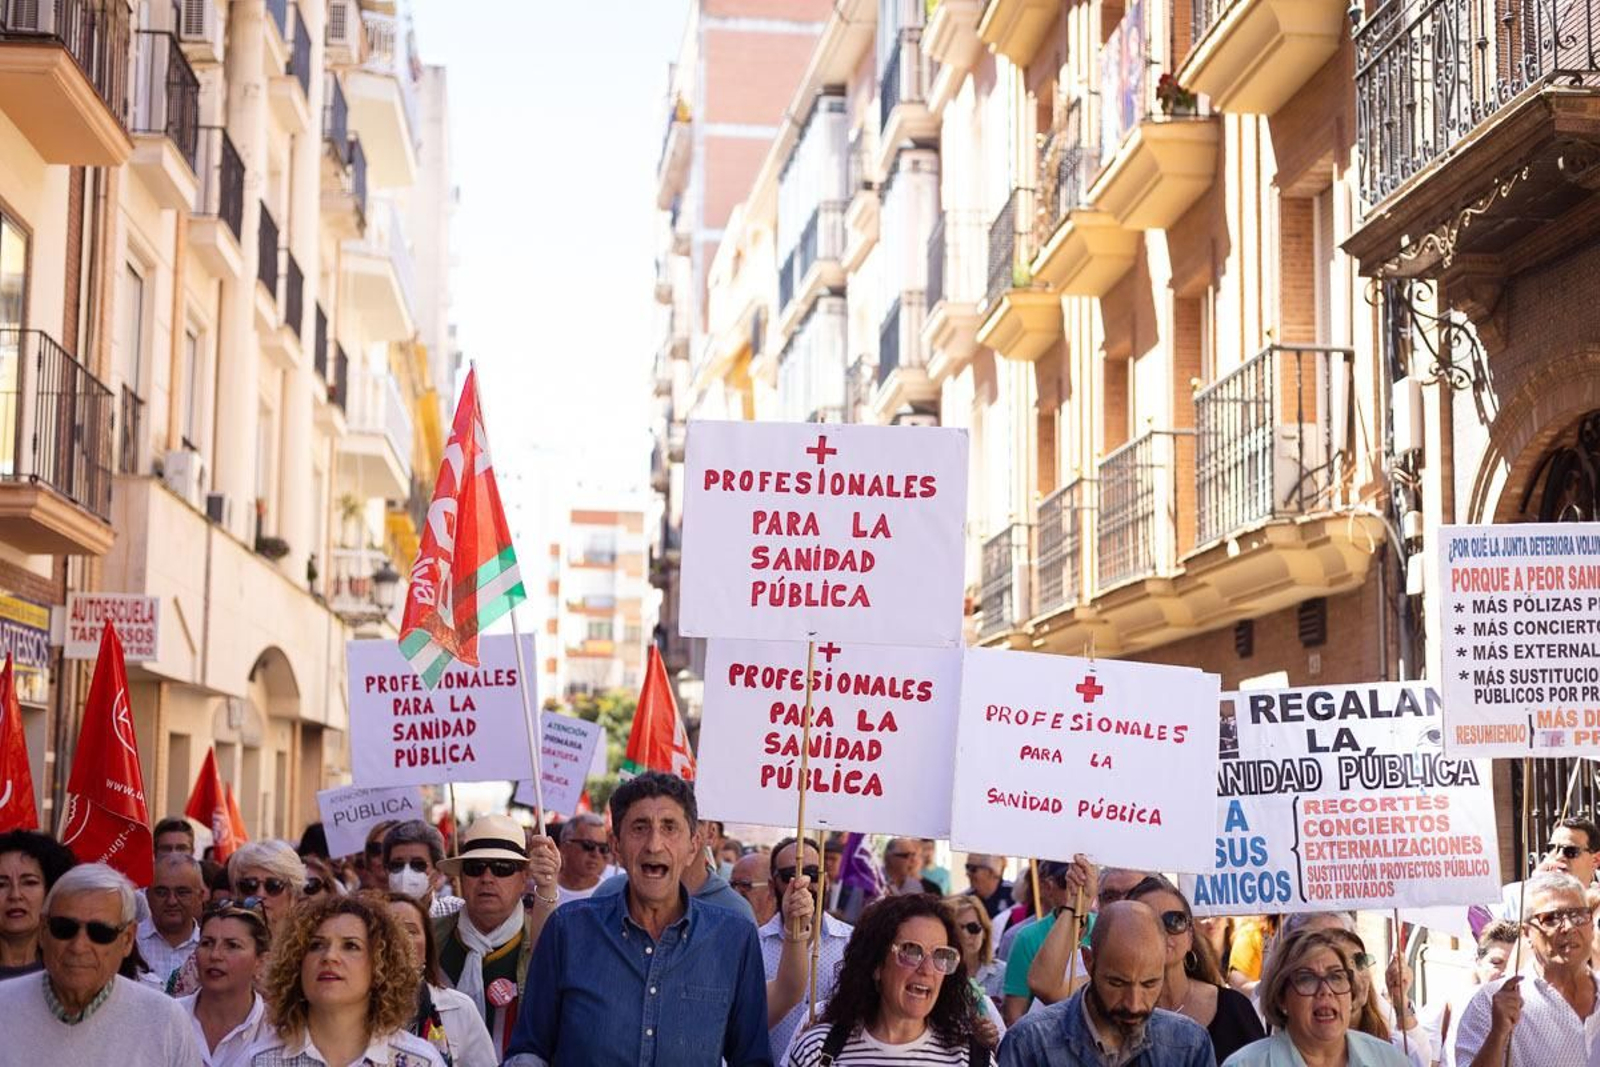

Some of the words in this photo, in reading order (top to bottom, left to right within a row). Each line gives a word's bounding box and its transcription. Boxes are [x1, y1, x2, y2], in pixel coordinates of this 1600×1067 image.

[703, 467, 937, 499] PROFESIONALES
[752, 510, 820, 537] PARA
[852, 511, 892, 539] LA
[751, 544, 876, 573] SANIDAD
[1471, 533, 1489, 559] QUÉ
[1490, 537, 1500, 557] LA
[1502, 537, 1530, 557] JUNTA
[1530, 536, 1575, 556] DETERIORA
[751, 576, 871, 608] PÚBLICA
[1452, 567, 1510, 593] PORQUE
[1514, 566, 1523, 591] A
[1527, 566, 1565, 591] PEOR
[71, 597, 154, 622] AUTOESCUELA
[1472, 596, 1508, 614] MÁS
[1513, 595, 1582, 613] PÓLIZAS
[1473, 619, 1509, 636] MÁS
[1473, 641, 1509, 660] MÁS
[728, 662, 933, 702] PROFESIONALES
[1473, 666, 1505, 685] MÁS
[1509, 667, 1599, 684] SUSTITUCIO
[393, 697, 434, 716] PARA
[450, 694, 476, 712] LA
[1474, 684, 1544, 704] PÚBLICOS
[1549, 686, 1577, 702] POR
[393, 718, 477, 742] SANIDAD
[857, 709, 898, 732] LA
[985, 704, 1188, 744] PROFESIONALES
[1537, 705, 1579, 729] MÁS
[764, 731, 883, 762] SANIDAD
[1306, 727, 1361, 753] LA
[1456, 724, 1526, 744] RESUMIENDO
[394, 742, 476, 768] PÚBLICA
[1020, 745, 1062, 763] PARA
[1090, 753, 1113, 769] LA
[1338, 747, 1480, 791] PÚBLICA
[333, 796, 413, 827] PÚBLICA
[987, 787, 1063, 814] SANIDAD
[1077, 798, 1162, 825] PÚBLICA
[1225, 799, 1249, 833] A
[1303, 794, 1450, 815] RECORTES
[1303, 814, 1450, 838] CONCIERTOS
[1304, 835, 1483, 861] EXTERNALIZACIONES
[1307, 859, 1378, 882] SUSTITUCIÓN
[1380, 861, 1442, 880] PROYECTOS
[1444, 857, 1490, 878] PÚBLICO
[1194, 870, 1292, 906] AMIGOS
[1308, 883, 1334, 900] POR
[1336, 880, 1395, 899] PRIVADOS
